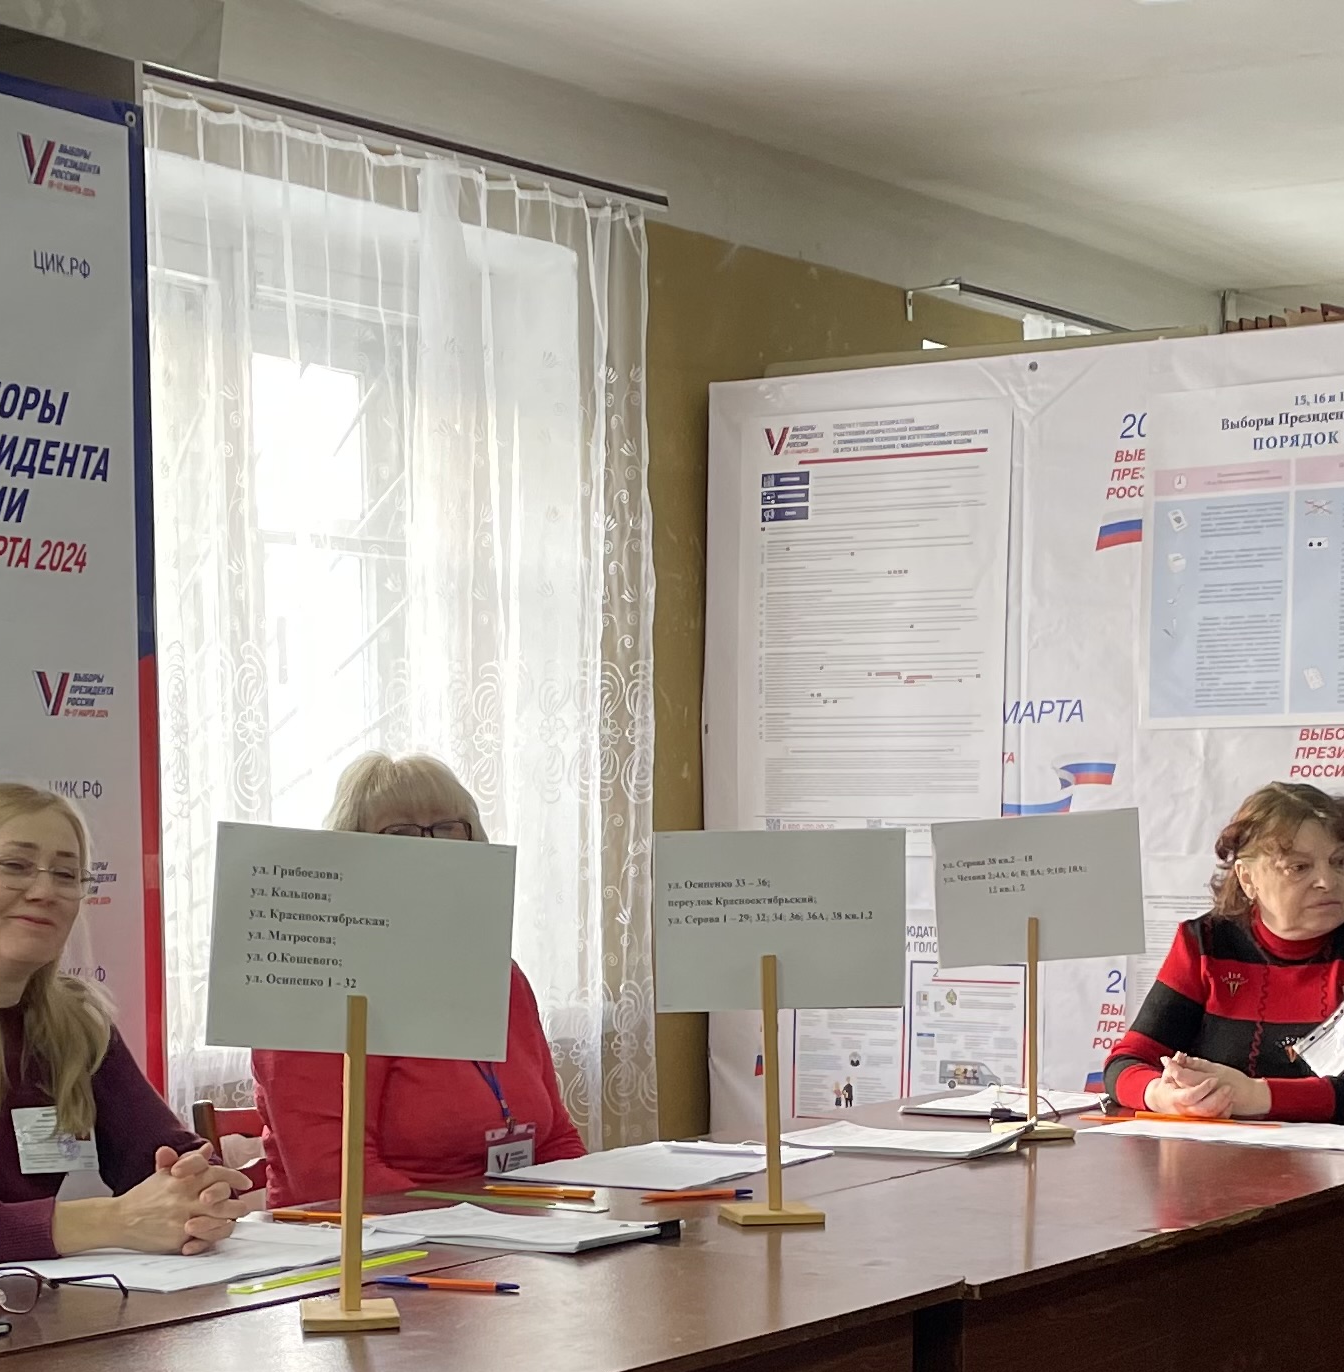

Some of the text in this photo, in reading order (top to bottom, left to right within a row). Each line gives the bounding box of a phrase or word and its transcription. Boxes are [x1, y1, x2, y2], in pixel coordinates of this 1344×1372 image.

[58, 143, 91, 160] ВЫБОРЫ
[55, 155, 101, 175] ПРЕЗИДЕНТА
[50, 168, 80, 182] РОССИИ
[33, 249, 91, 279] ЦИК.РФ
[1294, 395, 1311, 406] 15,
[1313, 393, 1326, 404] 16
[1328, 394, 1336, 403] и
[1221, 416, 1275, 431] Выборы
[1252, 430, 1339, 451] ПОРЯДОК
[33, 539, 87, 574] 2024
[988, 857, 997, 866] 38
[252, 865, 344, 881] ул. Грибоедова;
[667, 878, 771, 891] ул. Осипенко 33 36;
[250, 887, 332, 903] ул. Кольцова;
[667, 895, 817, 909] переулок Краснооктябрьский;
[249, 909, 390, 928] ул. Краснооктябрьская;
[667, 916, 682, 926] ул.
[684, 914, 720, 925] Серова
[756, 913, 770, 923] 32;
[831, 911, 842, 921] 38
[247, 930, 337, 945] ул. Матросова;
[246, 952, 343, 967] ул. О.Кошевого;
[245, 974, 263, 985] ул.
[266, 973, 324, 987] Осипенко
[344, 977, 357, 989] 32
